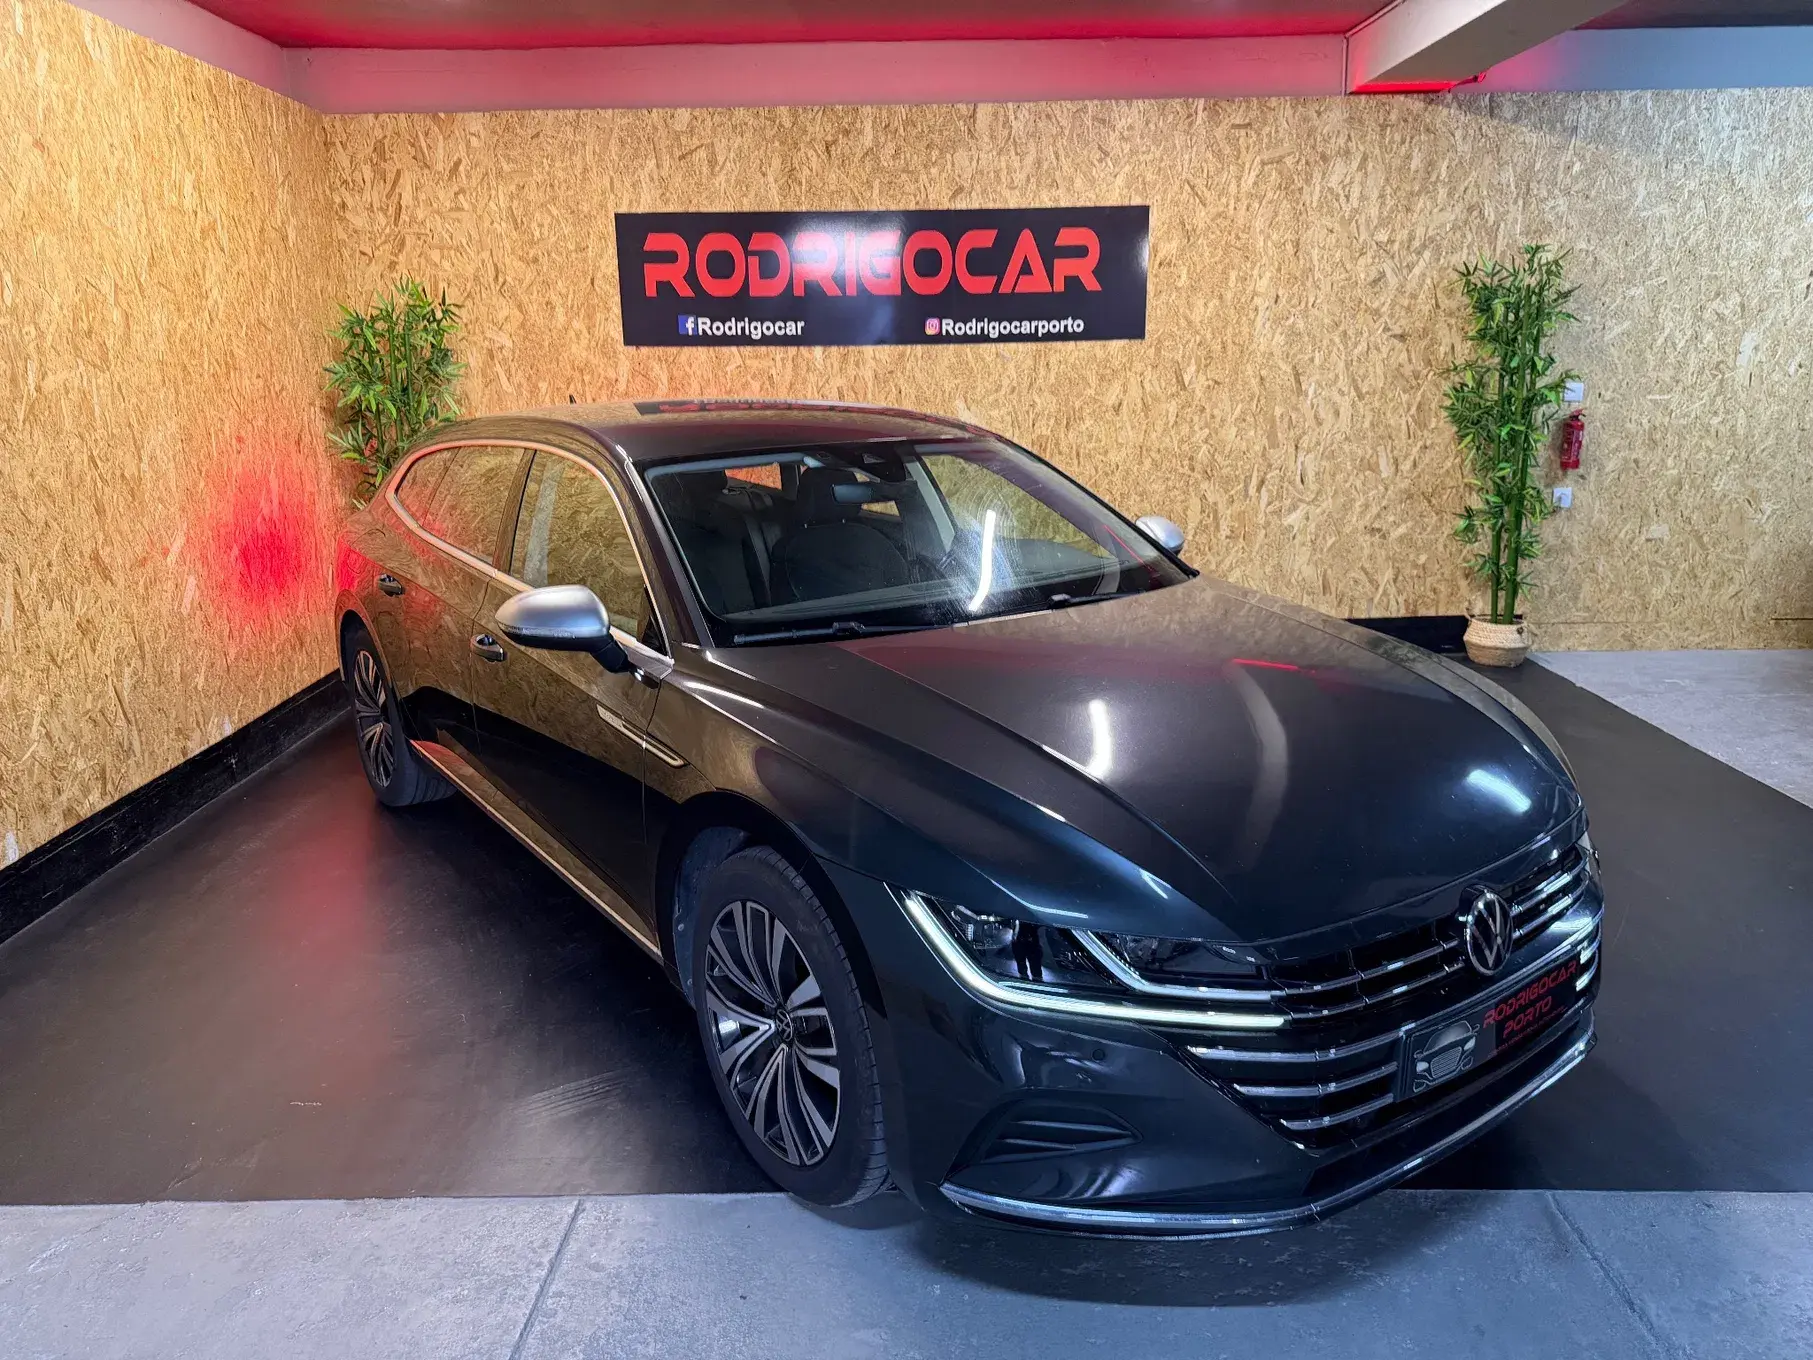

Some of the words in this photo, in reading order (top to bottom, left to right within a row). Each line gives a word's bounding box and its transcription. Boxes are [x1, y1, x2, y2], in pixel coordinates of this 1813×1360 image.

[643, 226, 1102, 297] RODRIGOCAR
[697, 317, 805, 340] Rodrigocar
[941, 316, 1085, 338] Rodrigocarporto
[1483, 960, 1578, 1028] RODRIGOCAR
[1503, 995, 1553, 1039] PORTO
